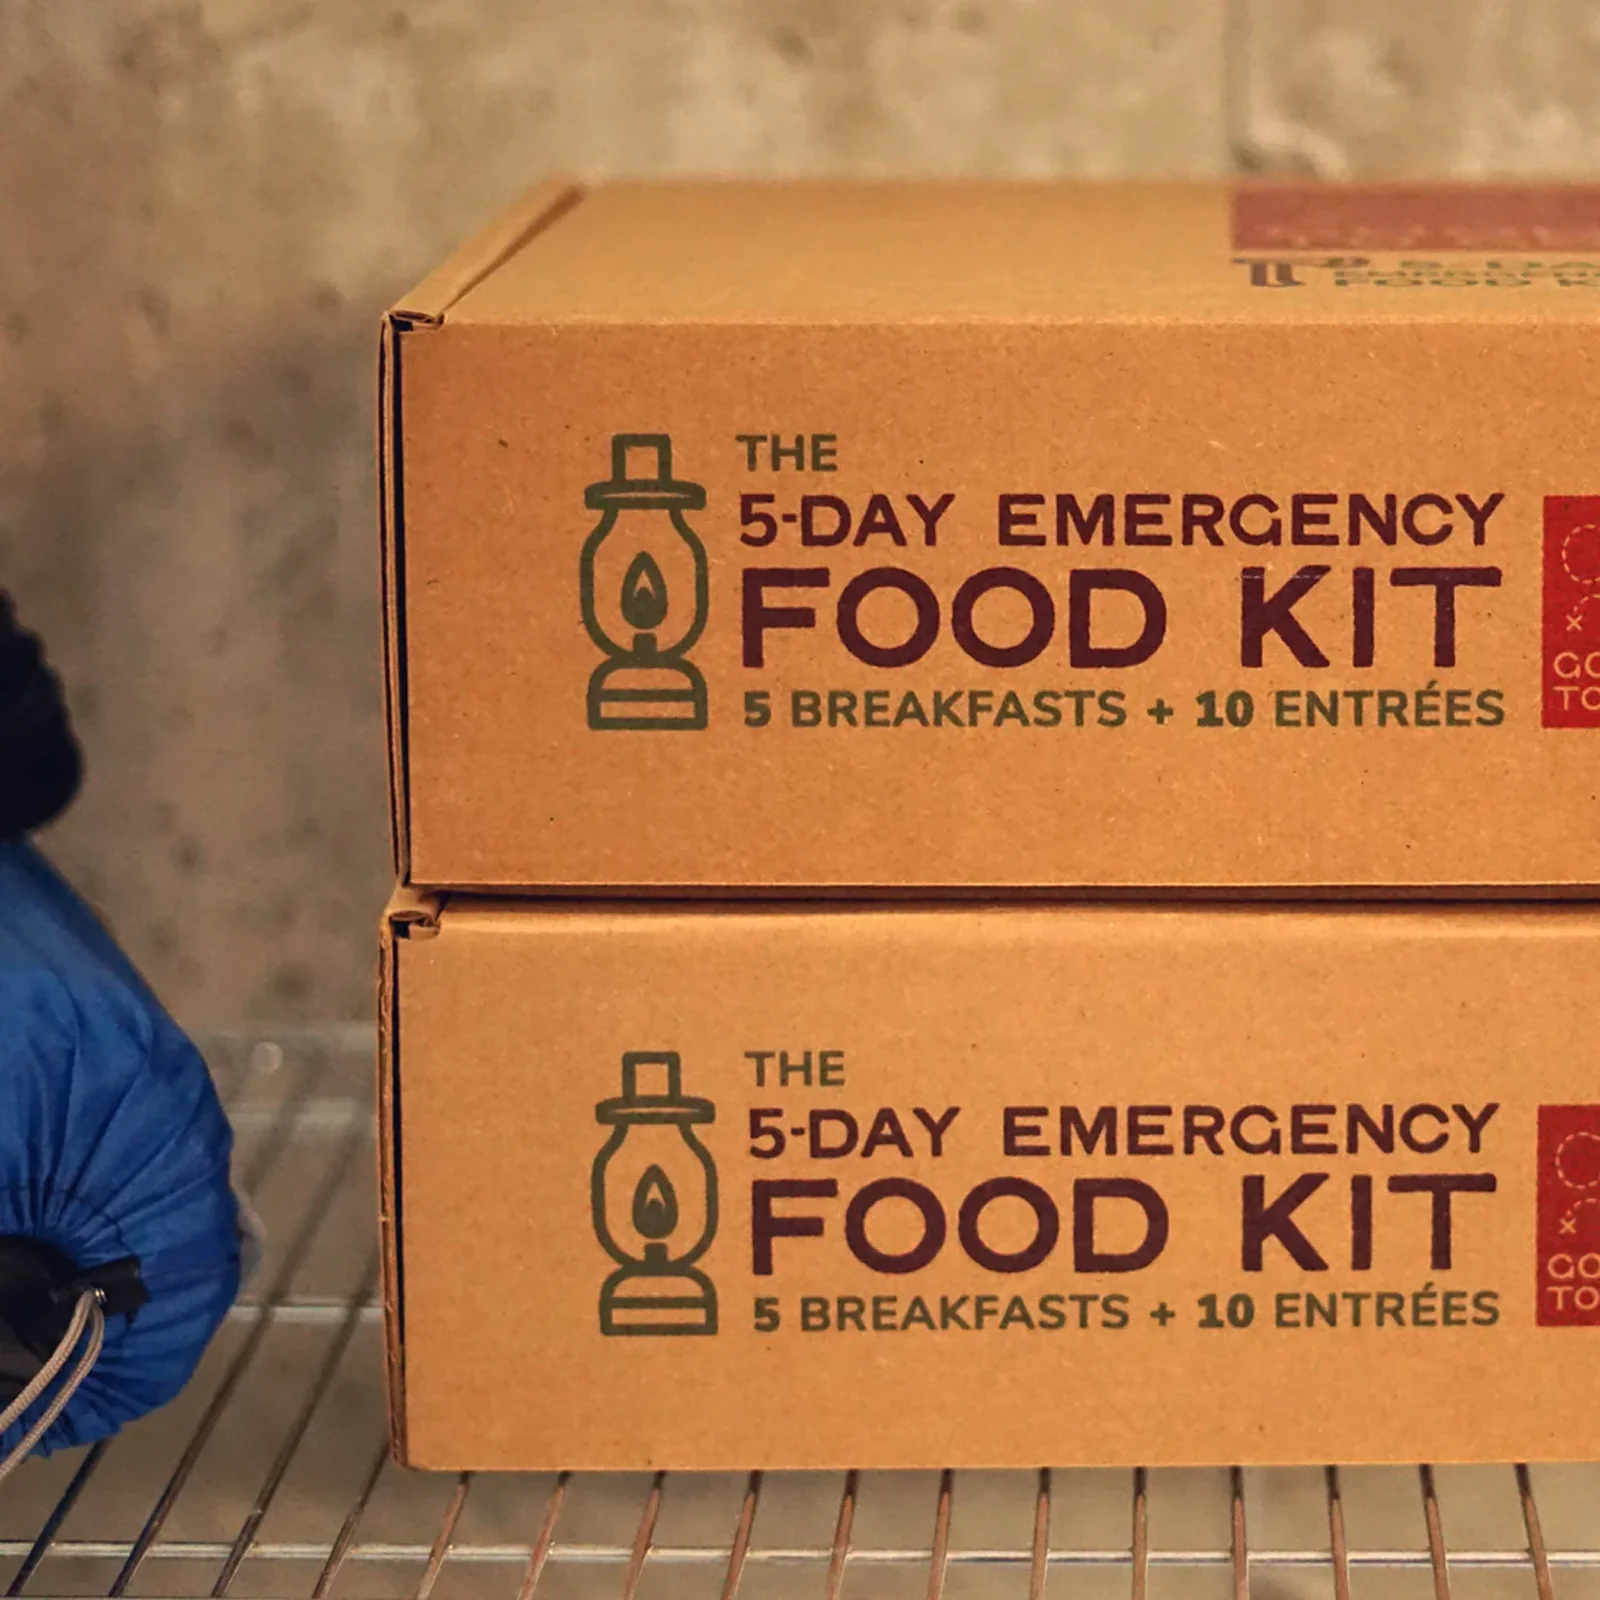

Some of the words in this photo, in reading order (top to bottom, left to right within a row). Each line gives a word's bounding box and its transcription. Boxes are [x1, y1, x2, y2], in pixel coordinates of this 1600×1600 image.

[736, 434, 838, 472] THE
[740, 494, 956, 547] 5-DAY
[999, 493, 1504, 547] EMERGENCY
[742, 566, 1166, 669] FOOD
[1241, 565, 1502, 669] KIT
[744, 690, 771, 728] 5
[792, 690, 1127, 728] BREAKFASTS
[1196, 690, 1254, 728] 10
[1276, 680, 1505, 728] ENTRÉES
[744, 1051, 845, 1087] THE
[750, 1107, 961, 1159] 5-DAY
[1004, 1103, 1500, 1157] EMERGENCY
[752, 1177, 1168, 1276] FOOD
[1242, 1173, 1497, 1273] KIT
[754, 1297, 781, 1332] 5
[801, 1294, 1129, 1332] BREAKFASTS
[1198, 1293, 1255, 1329] 10
[1276, 1282, 1500, 1328] ENTRÉES
[1547, 1286, 1600, 1311] TO
